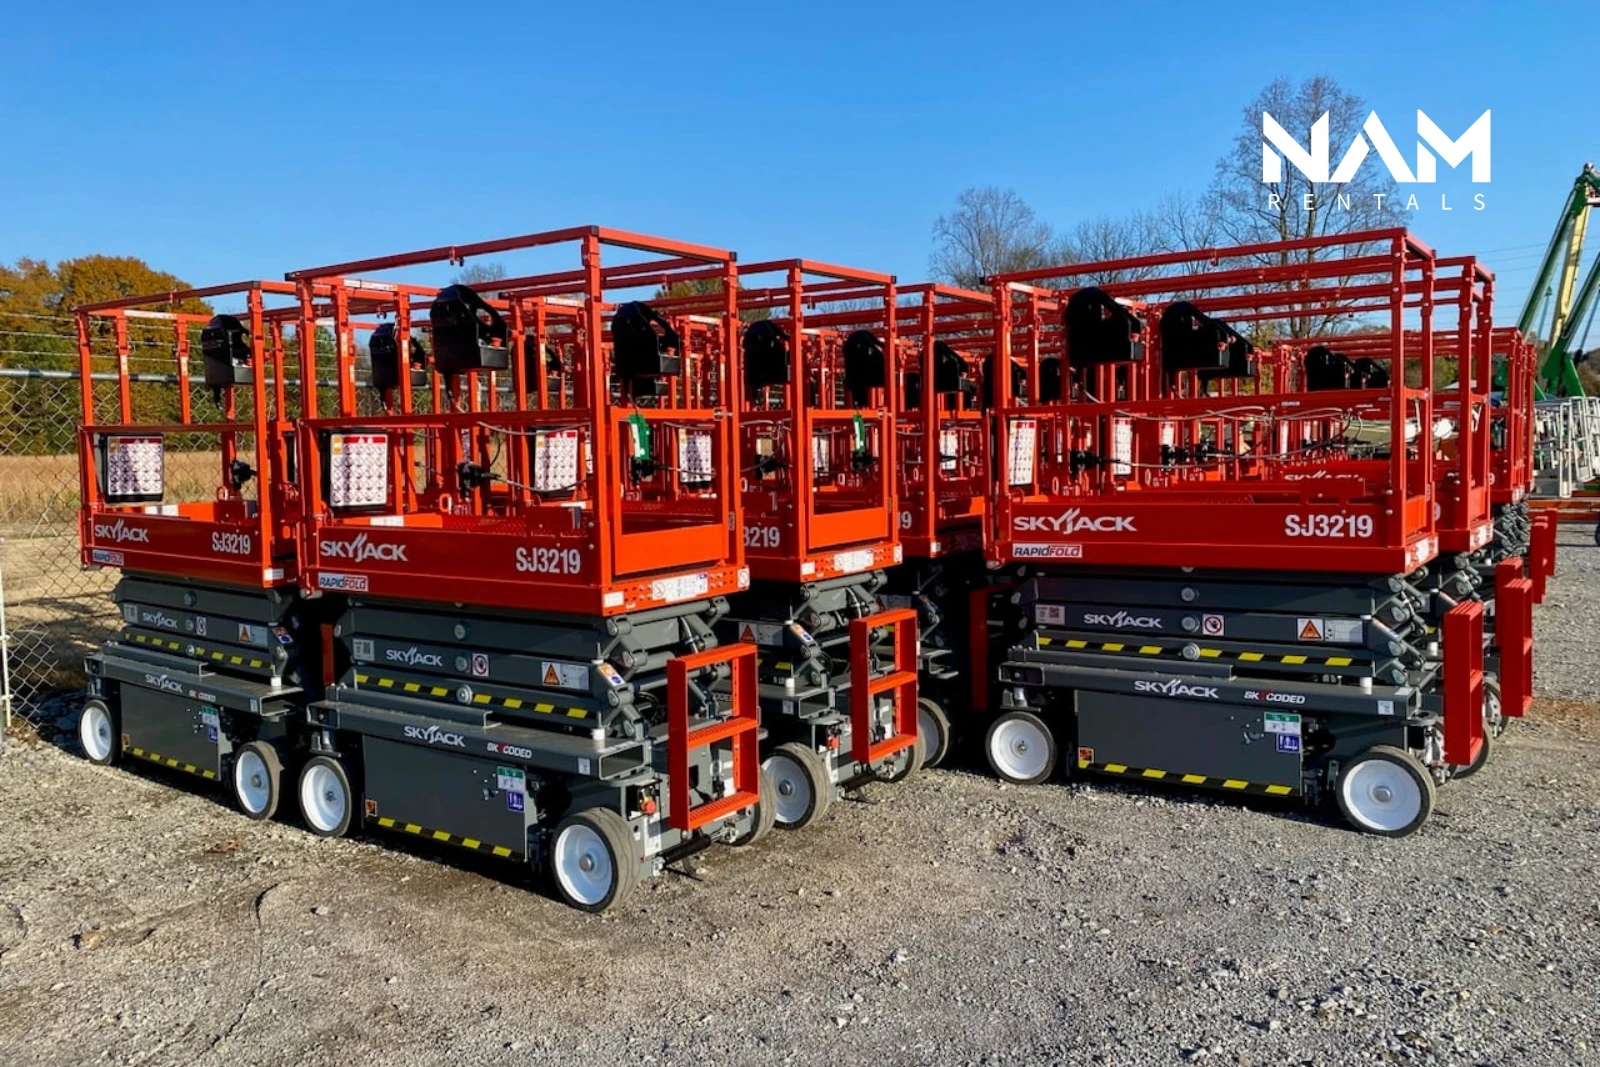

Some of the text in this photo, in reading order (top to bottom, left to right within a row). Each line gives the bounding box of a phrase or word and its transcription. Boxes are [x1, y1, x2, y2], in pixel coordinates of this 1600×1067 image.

[94, 518, 150, 543] SKYJACK
[1013, 507, 1138, 535] SKYJACK
[1284, 514, 1374, 538] SJ3219
[212, 531, 251, 555] SJ3219
[319, 532, 409, 562] SKYJACK
[515, 547, 581, 574] SJ3219
[1083, 611, 1163, 629] SKYJACK
[386, 646, 443, 667] SKYJACK
[1134, 678, 1220, 699] SKYJACK
[404, 724, 466, 748] SKYJACK
